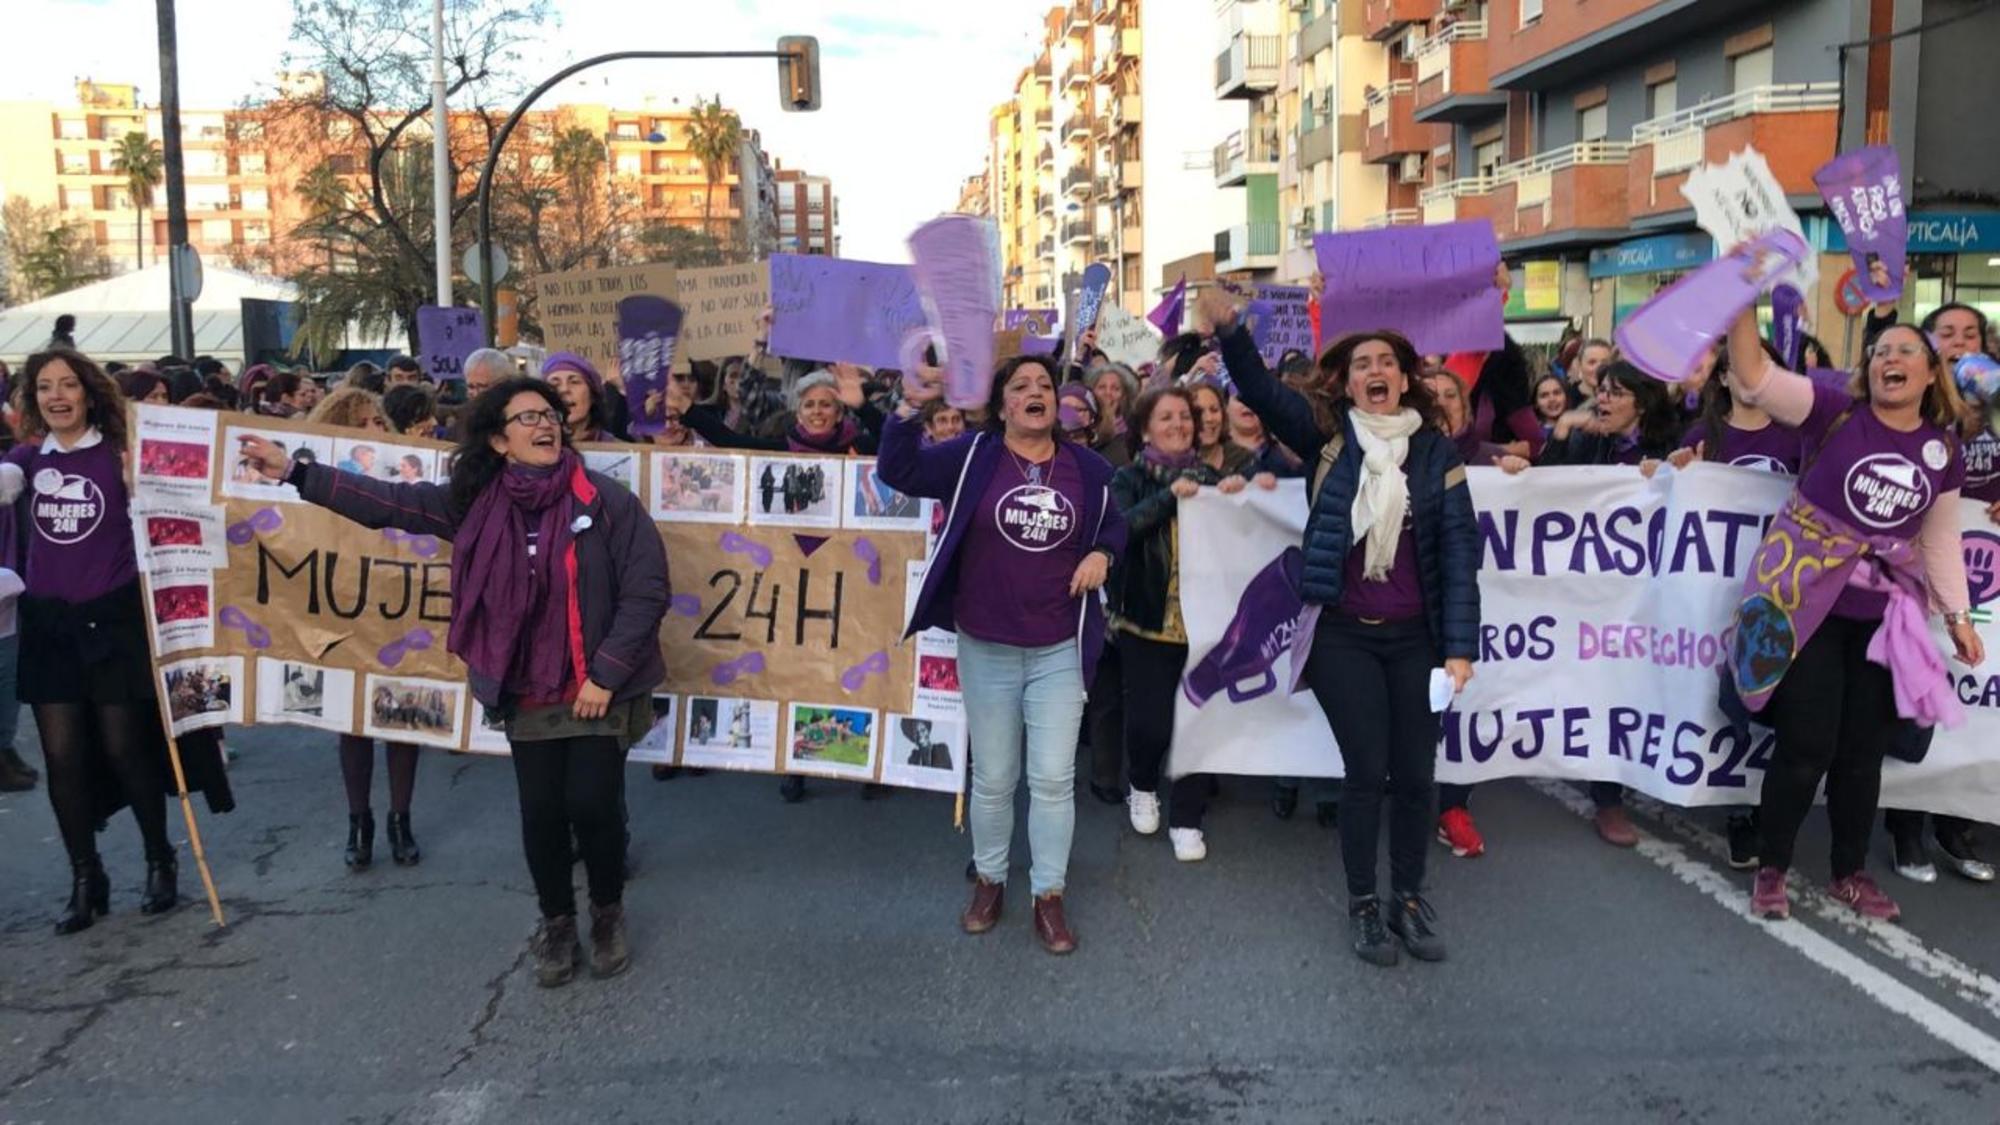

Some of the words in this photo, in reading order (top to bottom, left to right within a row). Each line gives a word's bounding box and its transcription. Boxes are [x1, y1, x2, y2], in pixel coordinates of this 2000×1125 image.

[1907, 217, 1979, 248] PTICALIA
[628, 273, 648, 292] LOS
[1853, 473, 1922, 511] MUJERES
[37, 502, 96, 519] MUJERES
[1005, 507, 1069, 532] MUJERES
[1864, 496, 1896, 520] 24H
[52, 518, 78, 534] 24H
[1021, 526, 1049, 542] 24H
[1477, 510, 1519, 571] N
[1532, 505, 1667, 577] PASO
[1669, 510, 1776, 578] AT
[256, 541, 453, 622] MUJE
[693, 568, 844, 649] 24H
[1481, 615, 1557, 663] ROS
[1947, 671, 2000, 707] CA
